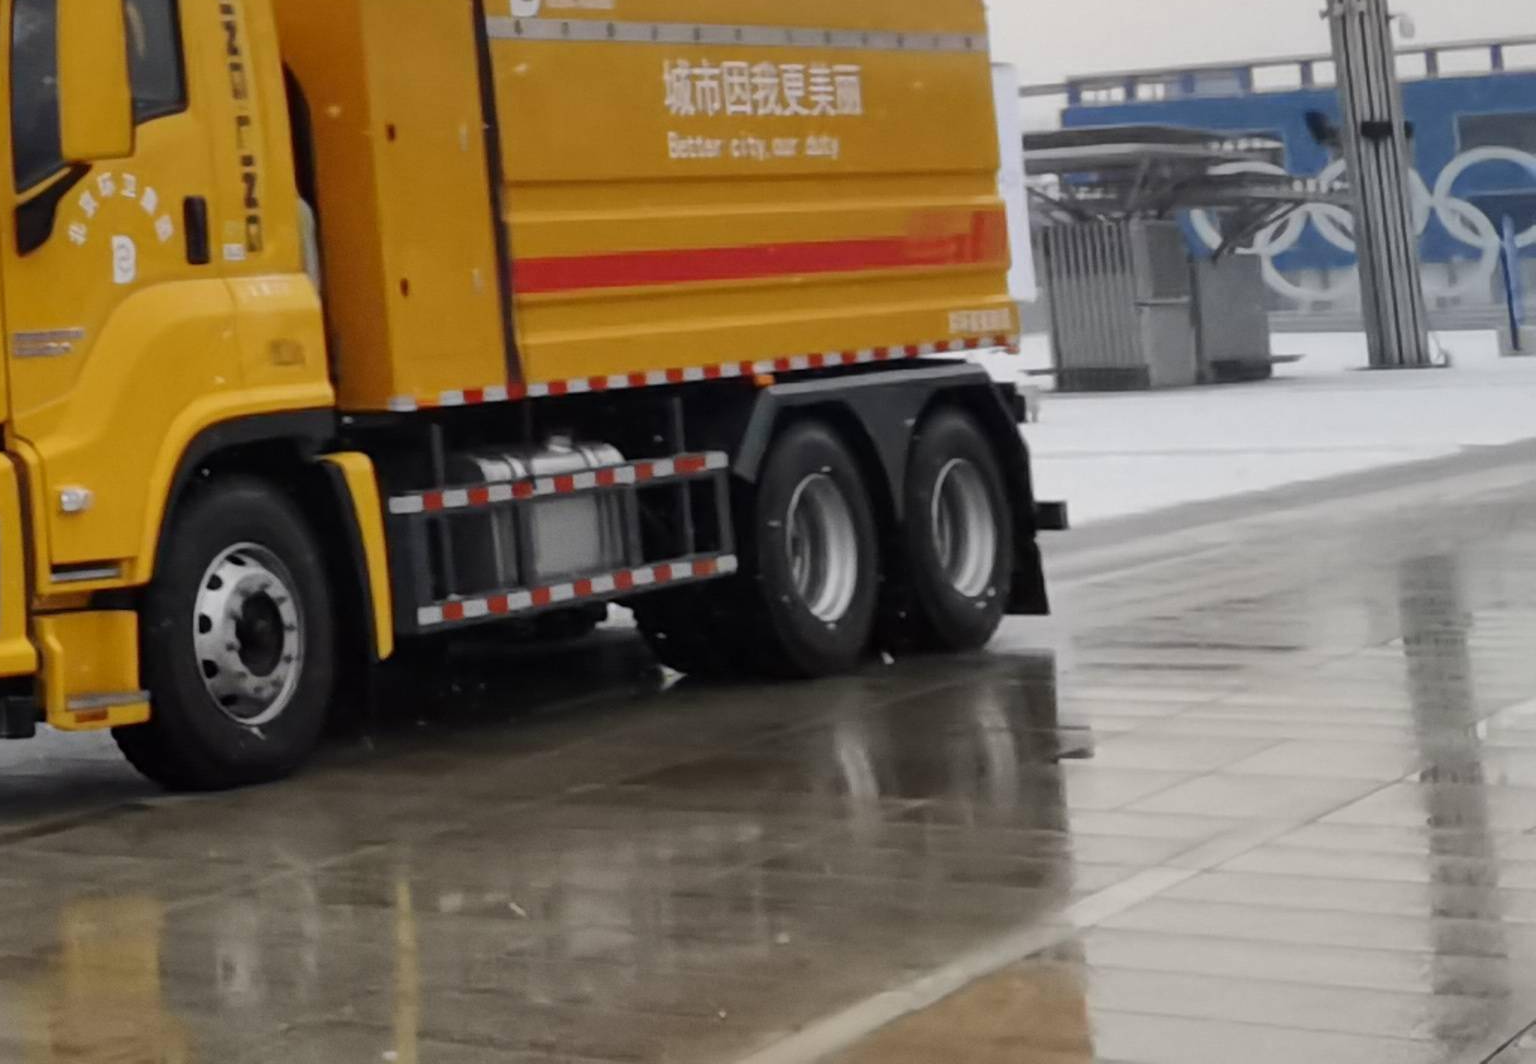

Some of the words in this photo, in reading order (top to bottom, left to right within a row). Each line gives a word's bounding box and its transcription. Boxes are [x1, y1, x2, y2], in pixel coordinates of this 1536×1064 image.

[663, 60, 863, 116] 城市因我更美丽
[667, 132, 722, 158] Better
